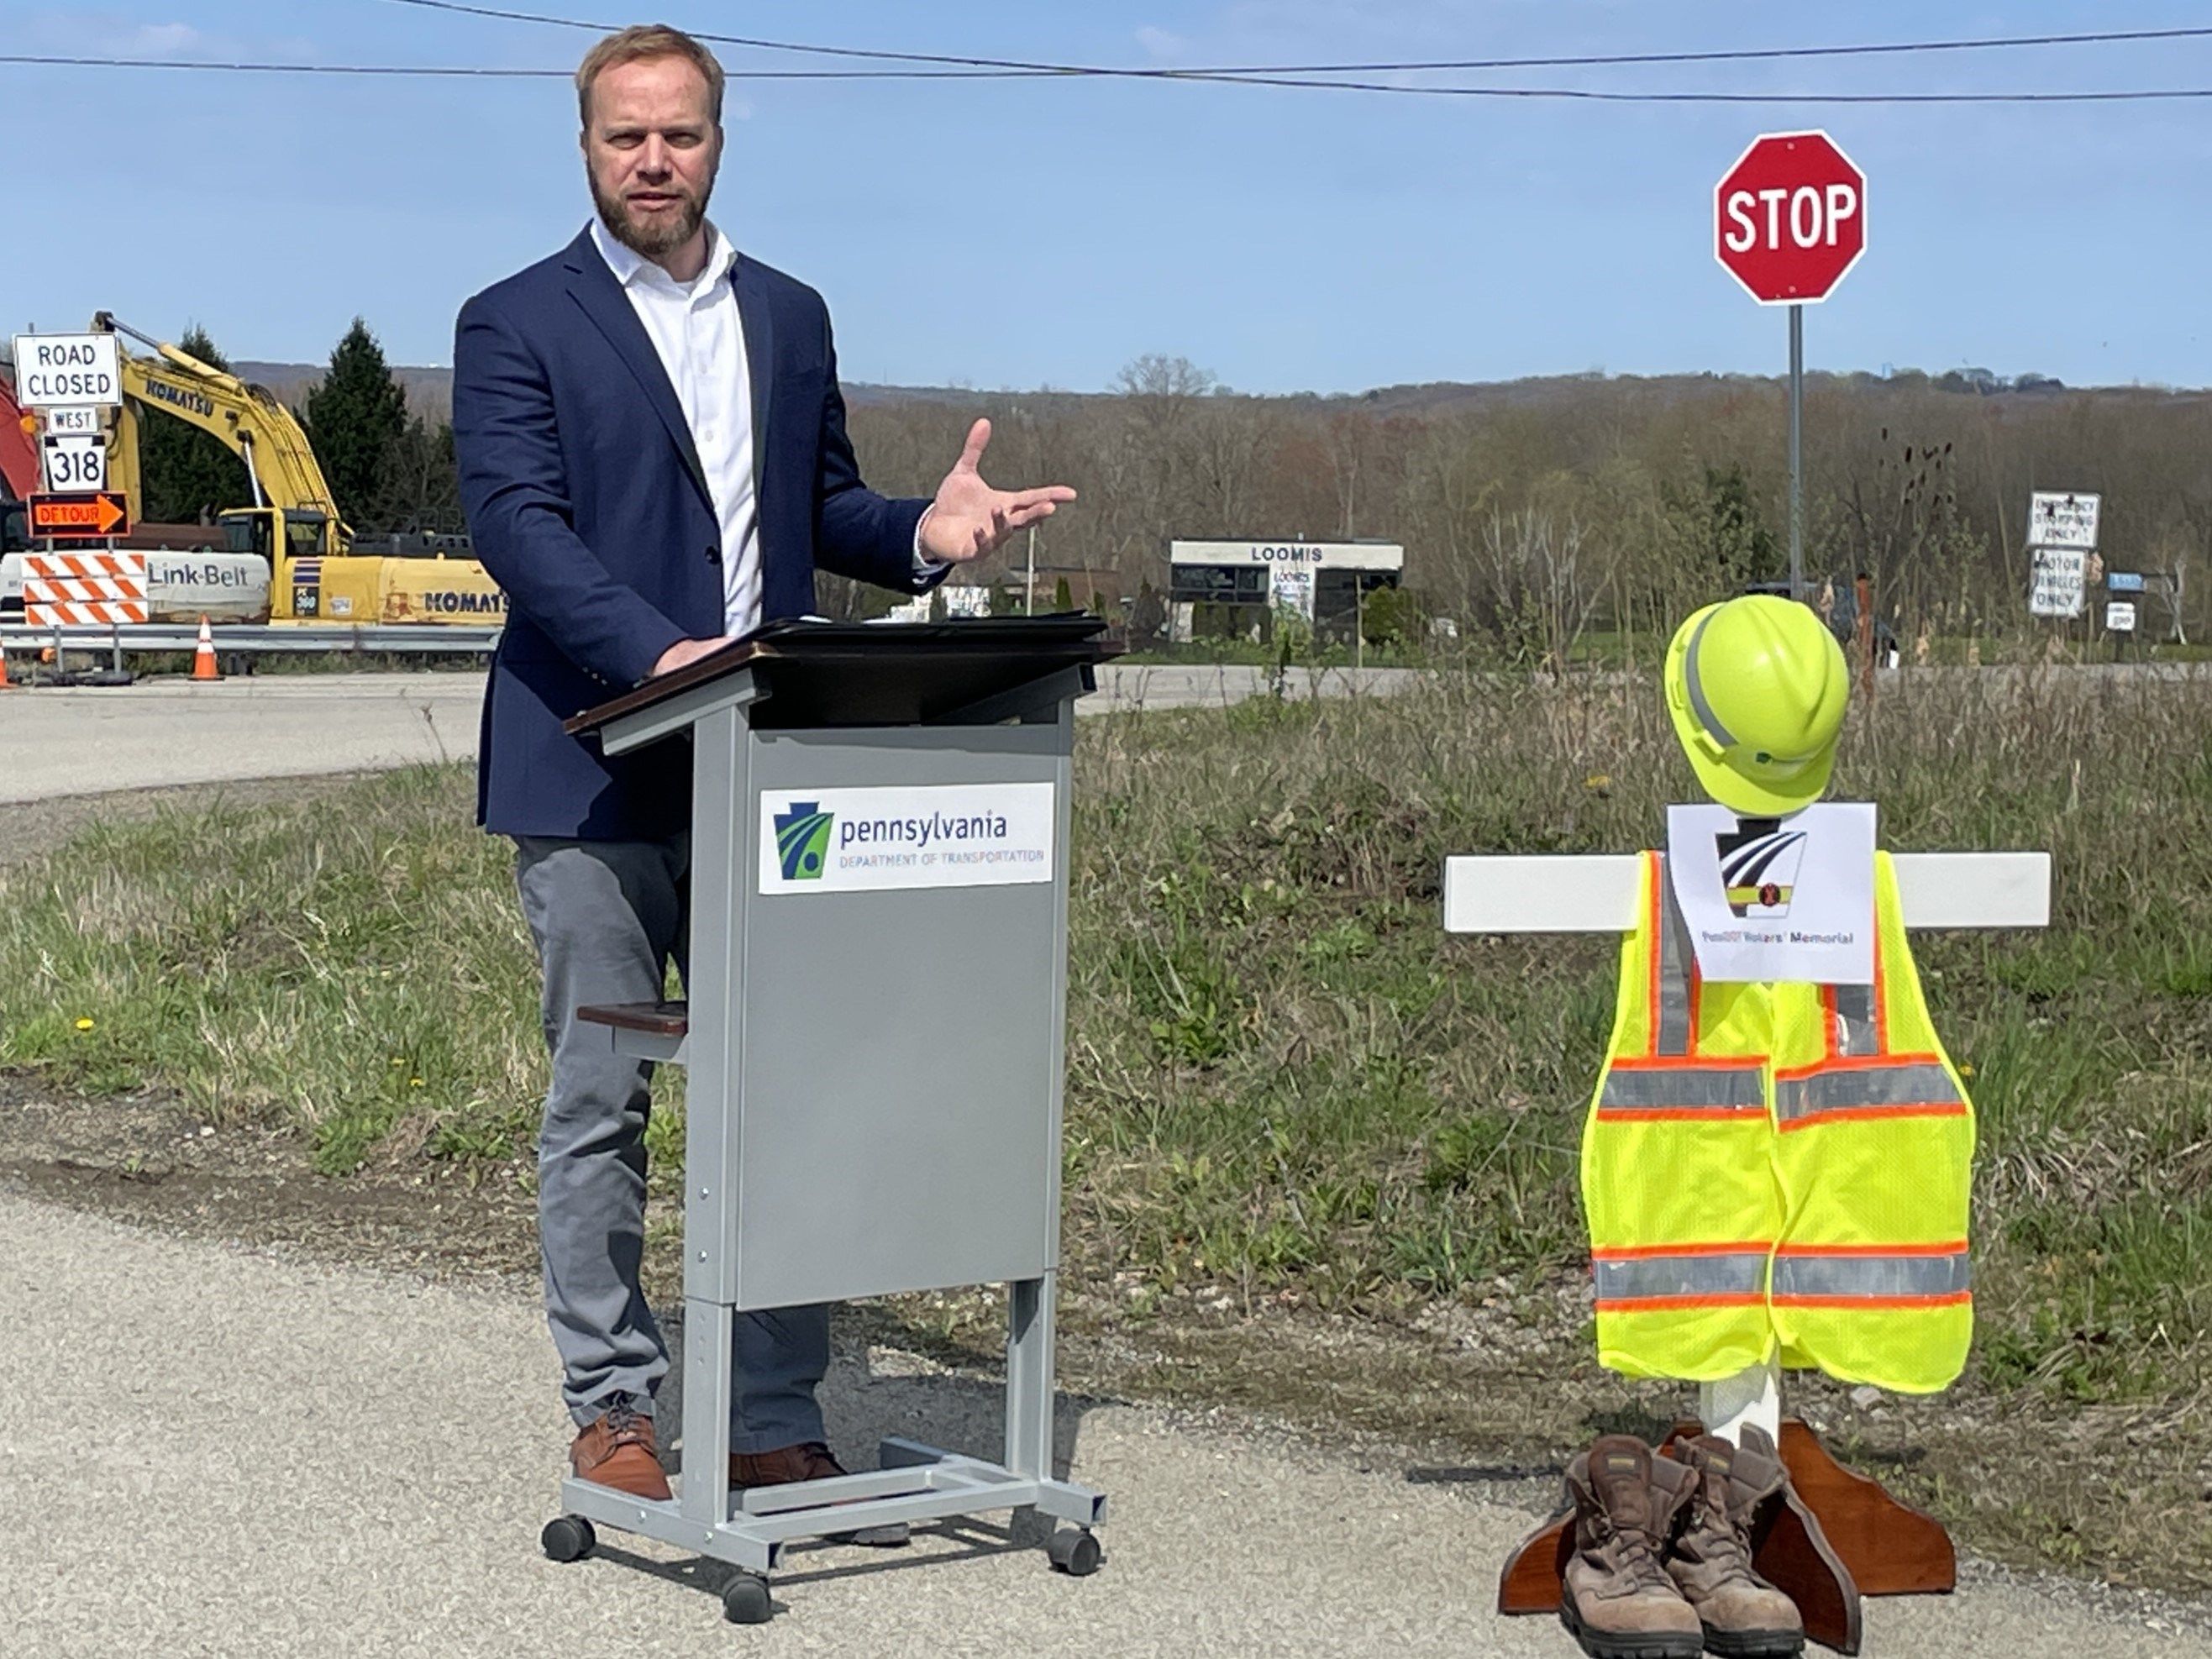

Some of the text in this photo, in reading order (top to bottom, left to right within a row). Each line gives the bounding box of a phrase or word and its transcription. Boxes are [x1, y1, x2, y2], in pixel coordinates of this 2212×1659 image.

[1725, 182, 1857, 253] STOP
[38, 344, 96, 366] ROAD
[29, 374, 111, 396] CLOSED
[146, 377, 214, 418] KOMATSU
[54, 412, 92, 428] WEST
[54, 451, 100, 483] 318
[40, 507, 100, 522] DETOUR
[1252, 546, 1322, 562] LOOMIS
[147, 562, 248, 587] Link-Belt
[424, 592, 511, 612] KOMATS
[2036, 592, 2075, 606] ONLY
[841, 810, 1007, 850] pennsylvania
[839, 849, 1044, 869] DEPARTMENT OF TRANSPORTATION
[1790, 932, 1854, 944] Memorial
